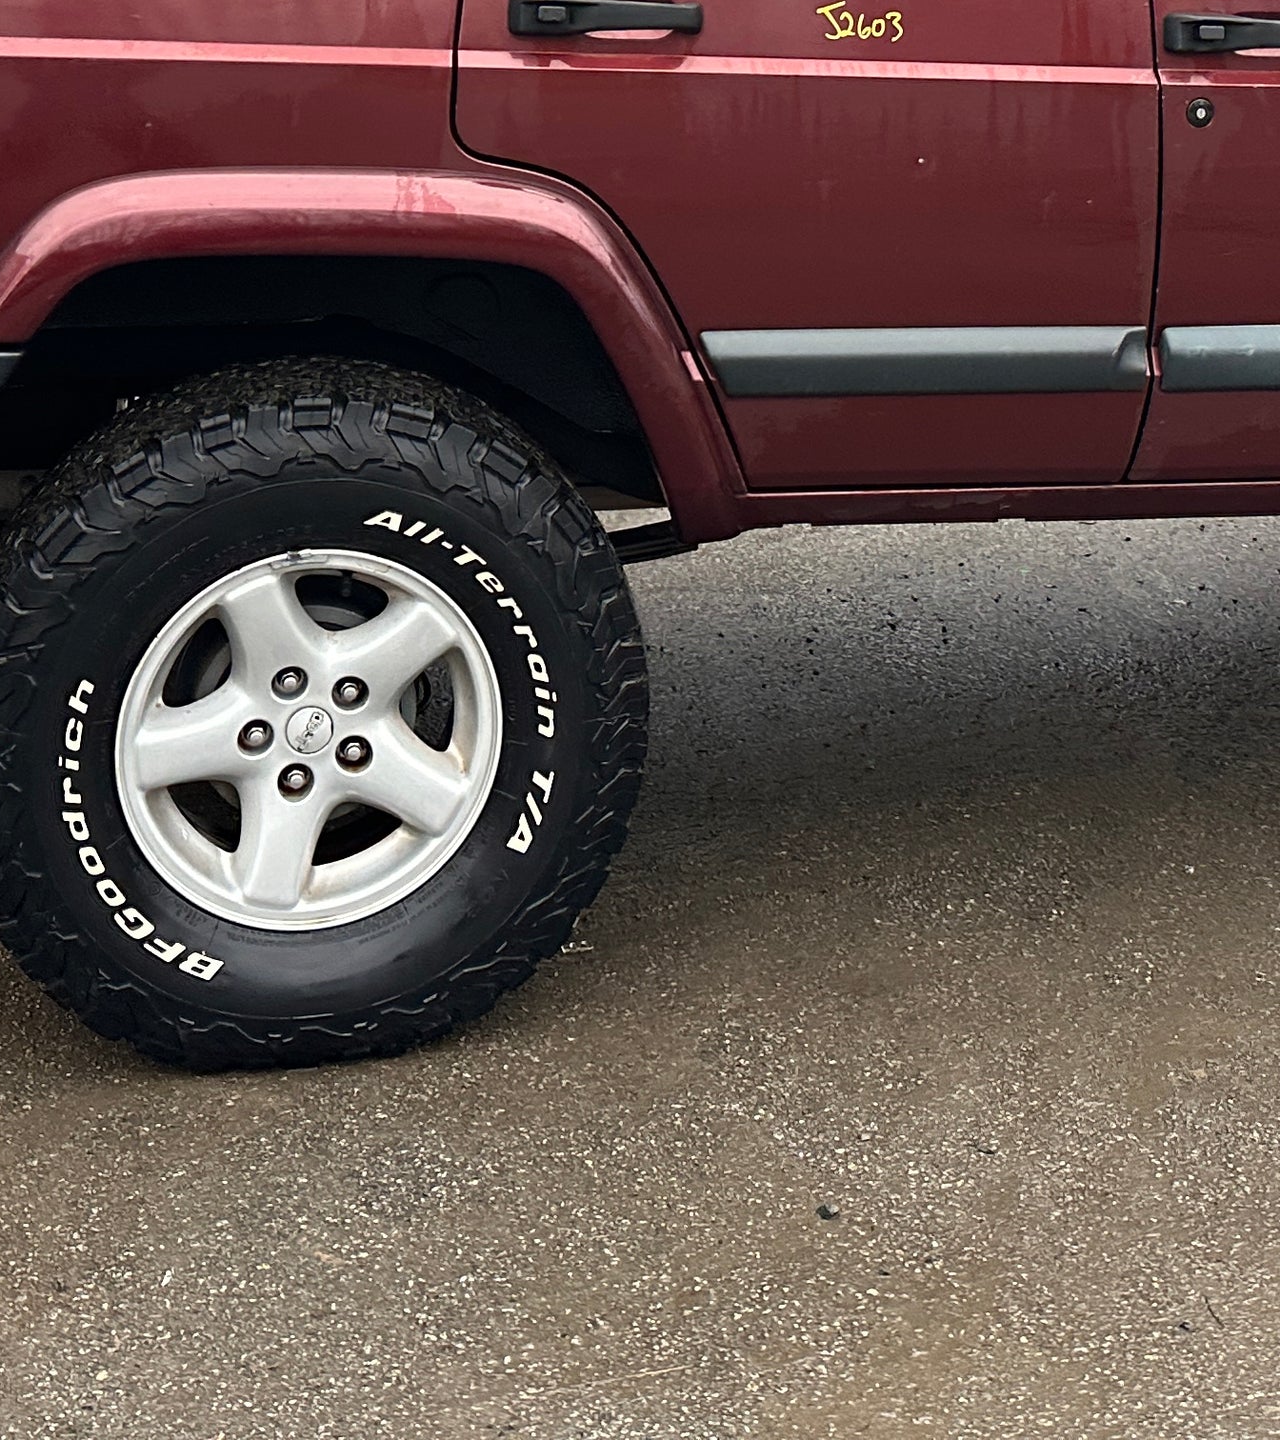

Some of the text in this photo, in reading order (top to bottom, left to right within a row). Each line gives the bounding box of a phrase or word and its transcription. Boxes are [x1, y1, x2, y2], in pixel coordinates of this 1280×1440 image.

[815, 0, 905, 43] J2603
[58, 679, 226, 981] BFGoodrich
[363, 510, 560, 854] All-Terrain T/A
